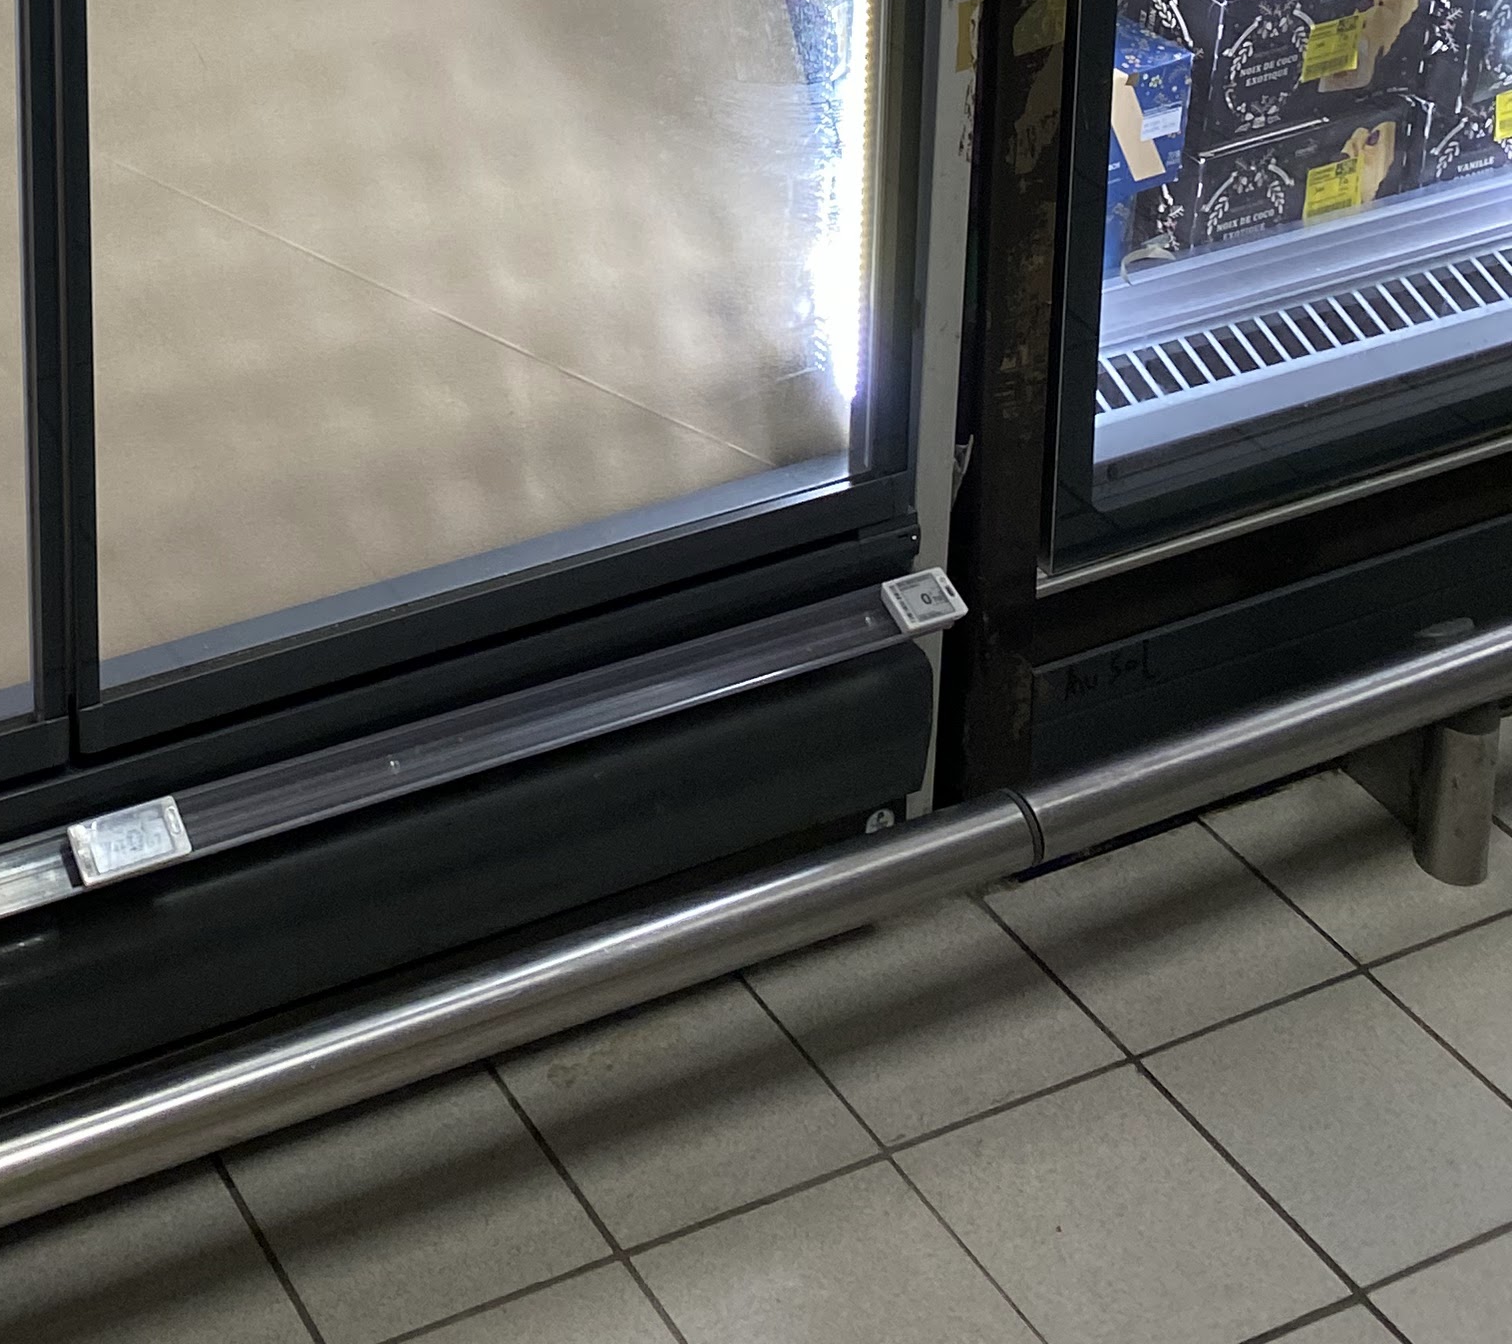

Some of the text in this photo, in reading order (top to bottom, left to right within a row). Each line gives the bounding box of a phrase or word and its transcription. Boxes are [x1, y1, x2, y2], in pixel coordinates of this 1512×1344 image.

[1263, 61, 1275, 70] DE
[1245, 67, 1289, 87] EXOTIQUE
[1456, 155, 1495, 173] VANILLE
